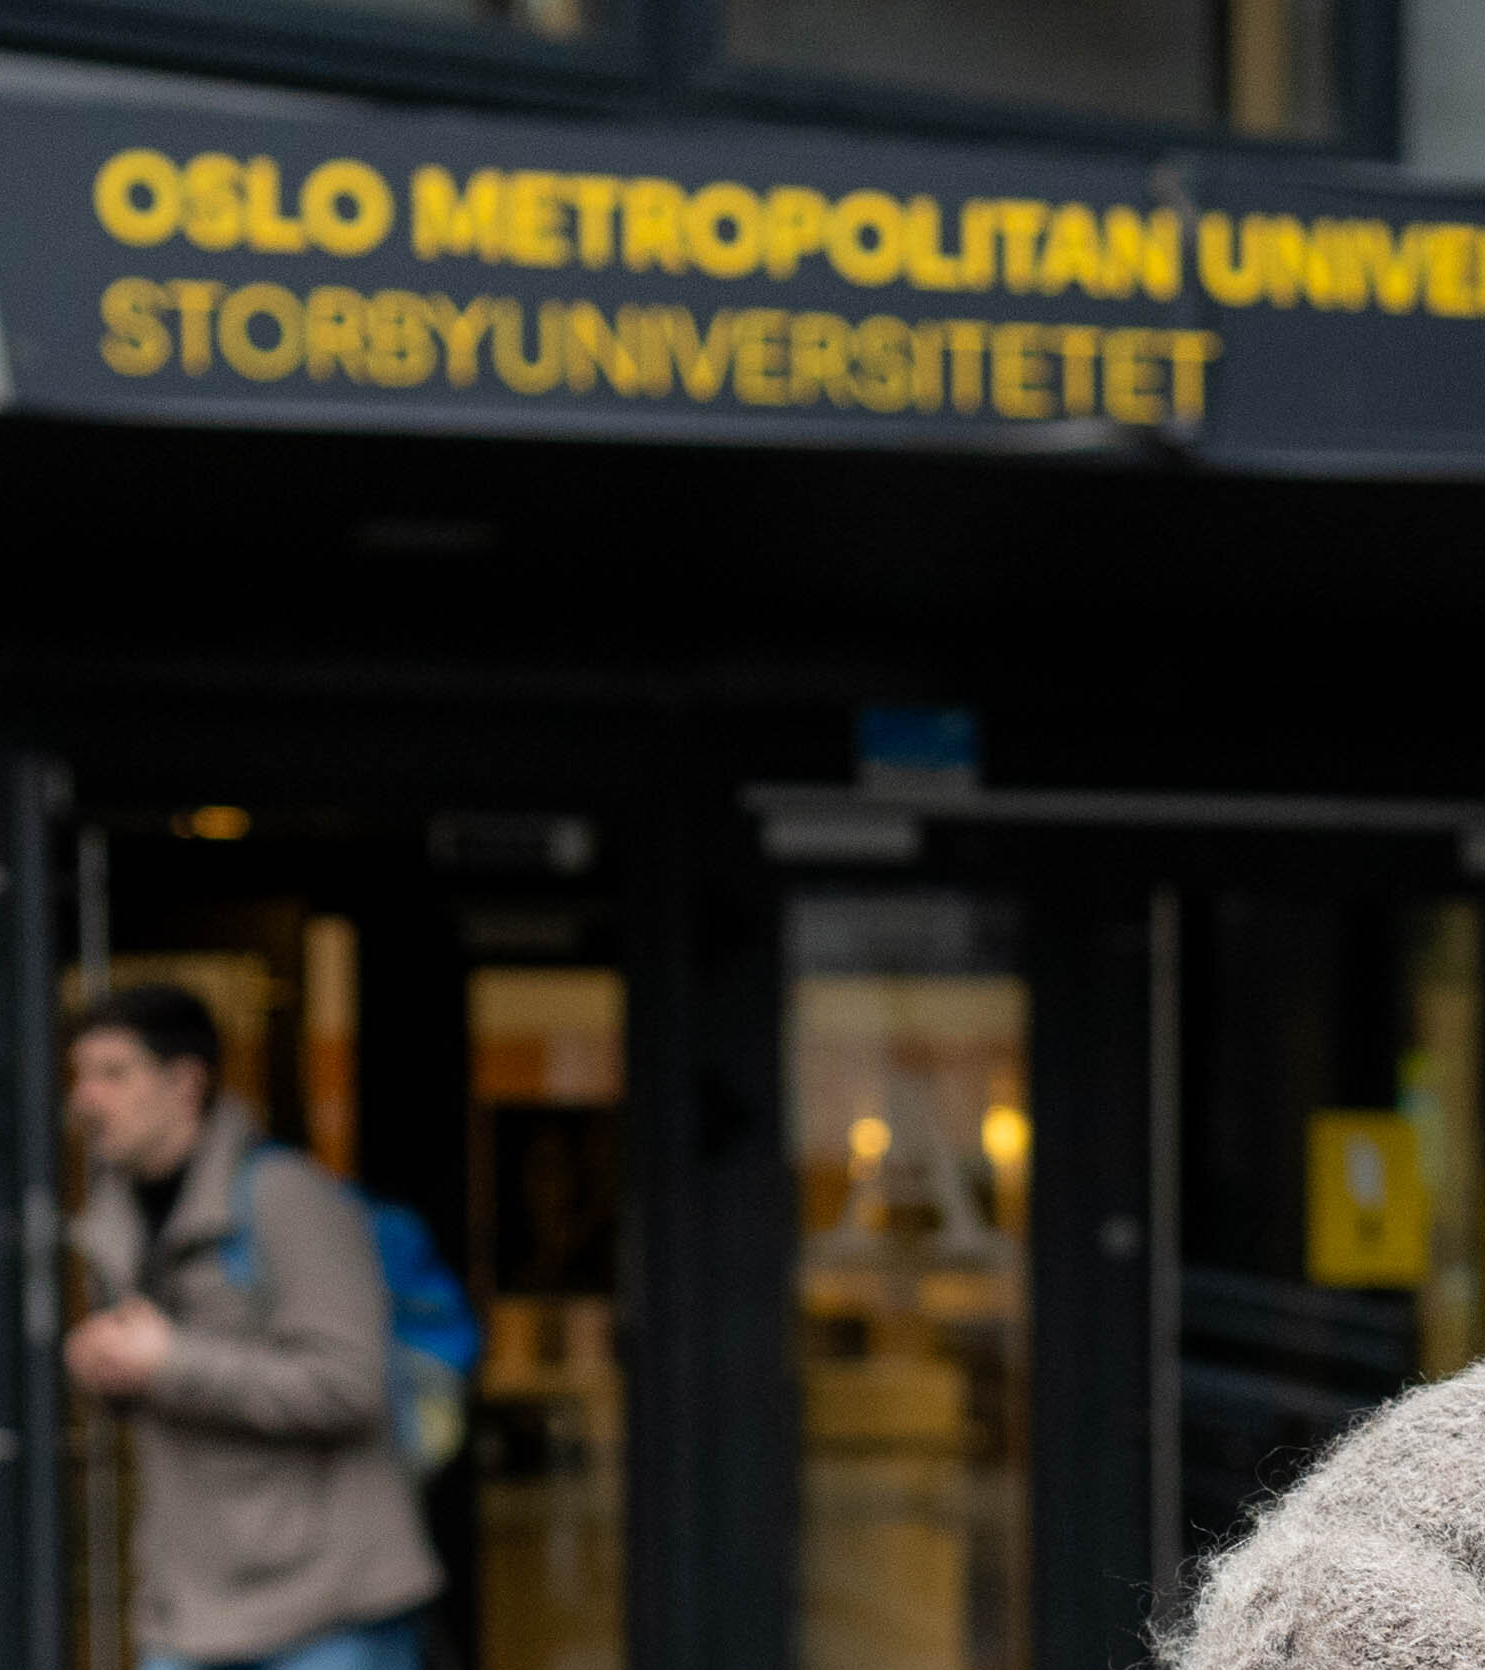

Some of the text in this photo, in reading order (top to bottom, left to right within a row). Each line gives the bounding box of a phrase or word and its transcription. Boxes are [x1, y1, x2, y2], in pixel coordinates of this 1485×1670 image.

[95, 151, 392, 255] OSLO
[412, 167, 1181, 300] METROPOLITAN
[103, 276, 1221, 422] STORBYUNIVERSITETET
